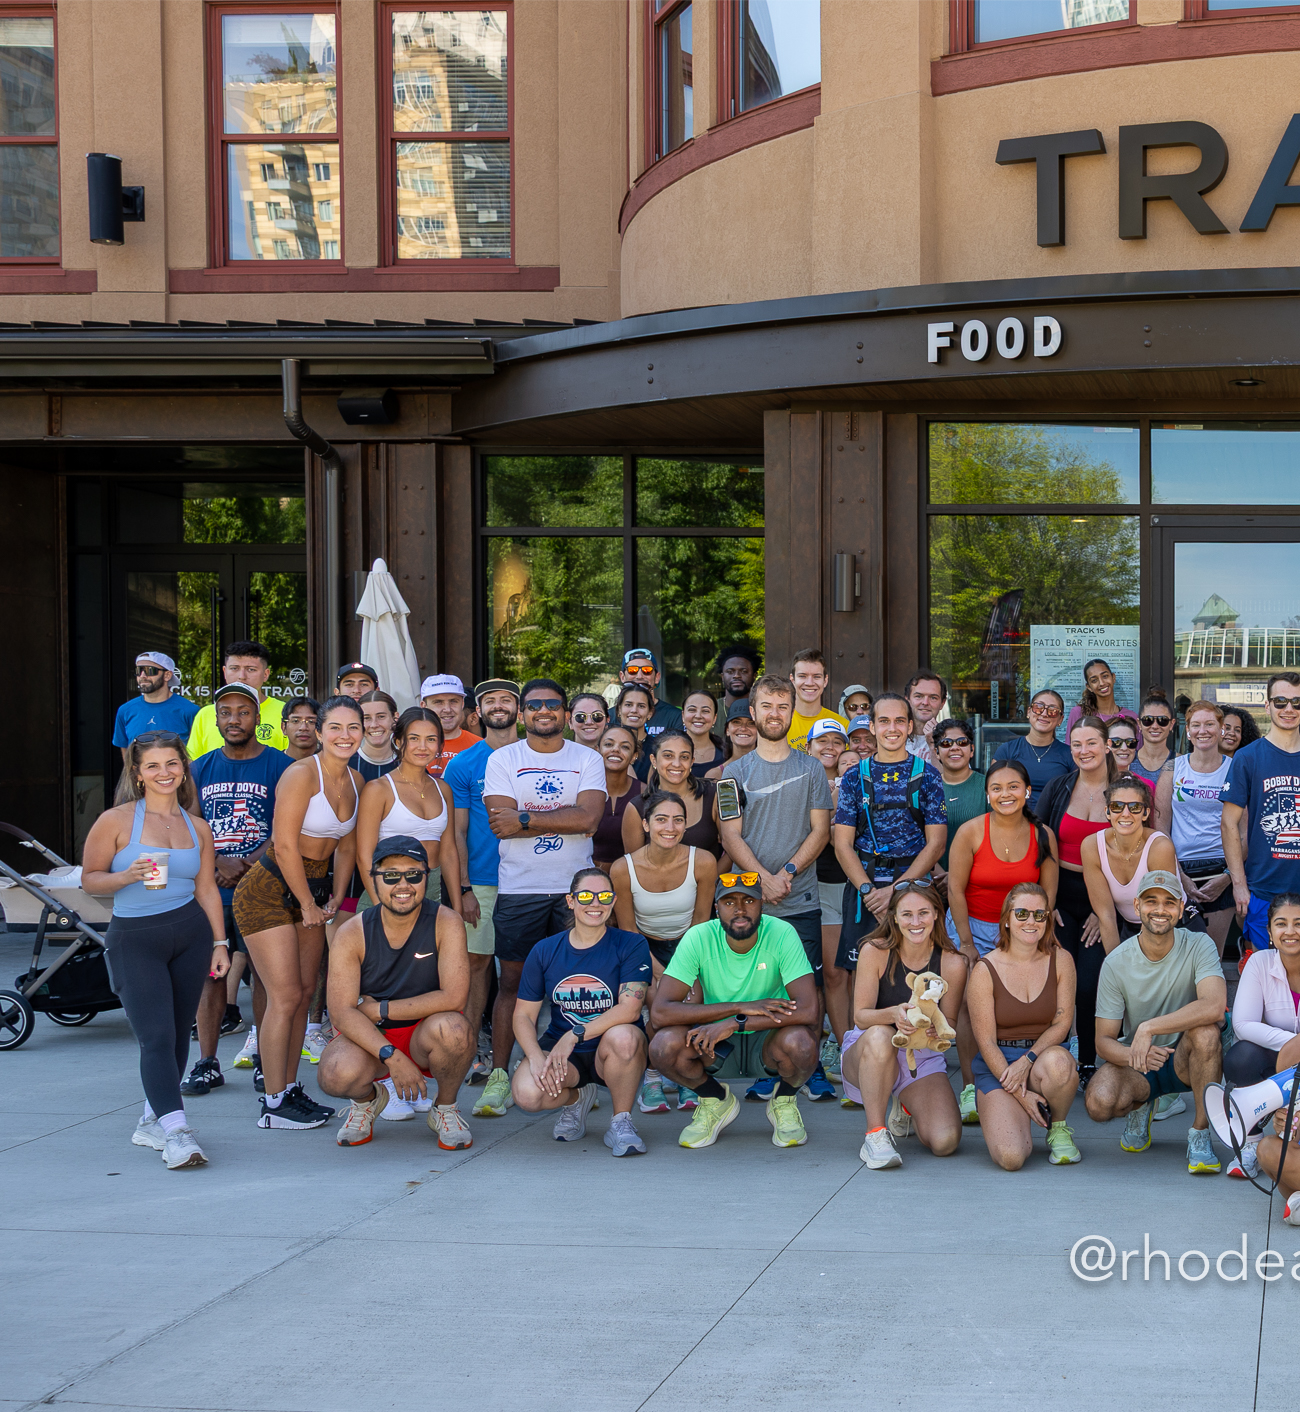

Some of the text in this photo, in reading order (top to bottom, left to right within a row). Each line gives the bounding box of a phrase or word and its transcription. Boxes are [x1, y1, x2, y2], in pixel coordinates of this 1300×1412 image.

[928, 316, 1063, 363] FOOD
[1033, 639, 1060, 647] PATIO
[1066, 639, 1083, 647] BAR
[194, 685, 210, 697] 15
[201, 782, 268, 801] BOBBY DOYLE
[1263, 775, 1292, 793] BOBBY
[1193, 789, 1220, 800] PRIDE
[534, 834, 564, 855] 250
[581, 998, 611, 1010] ISLAND
[1253, 1101, 1268, 1117] PYLE
